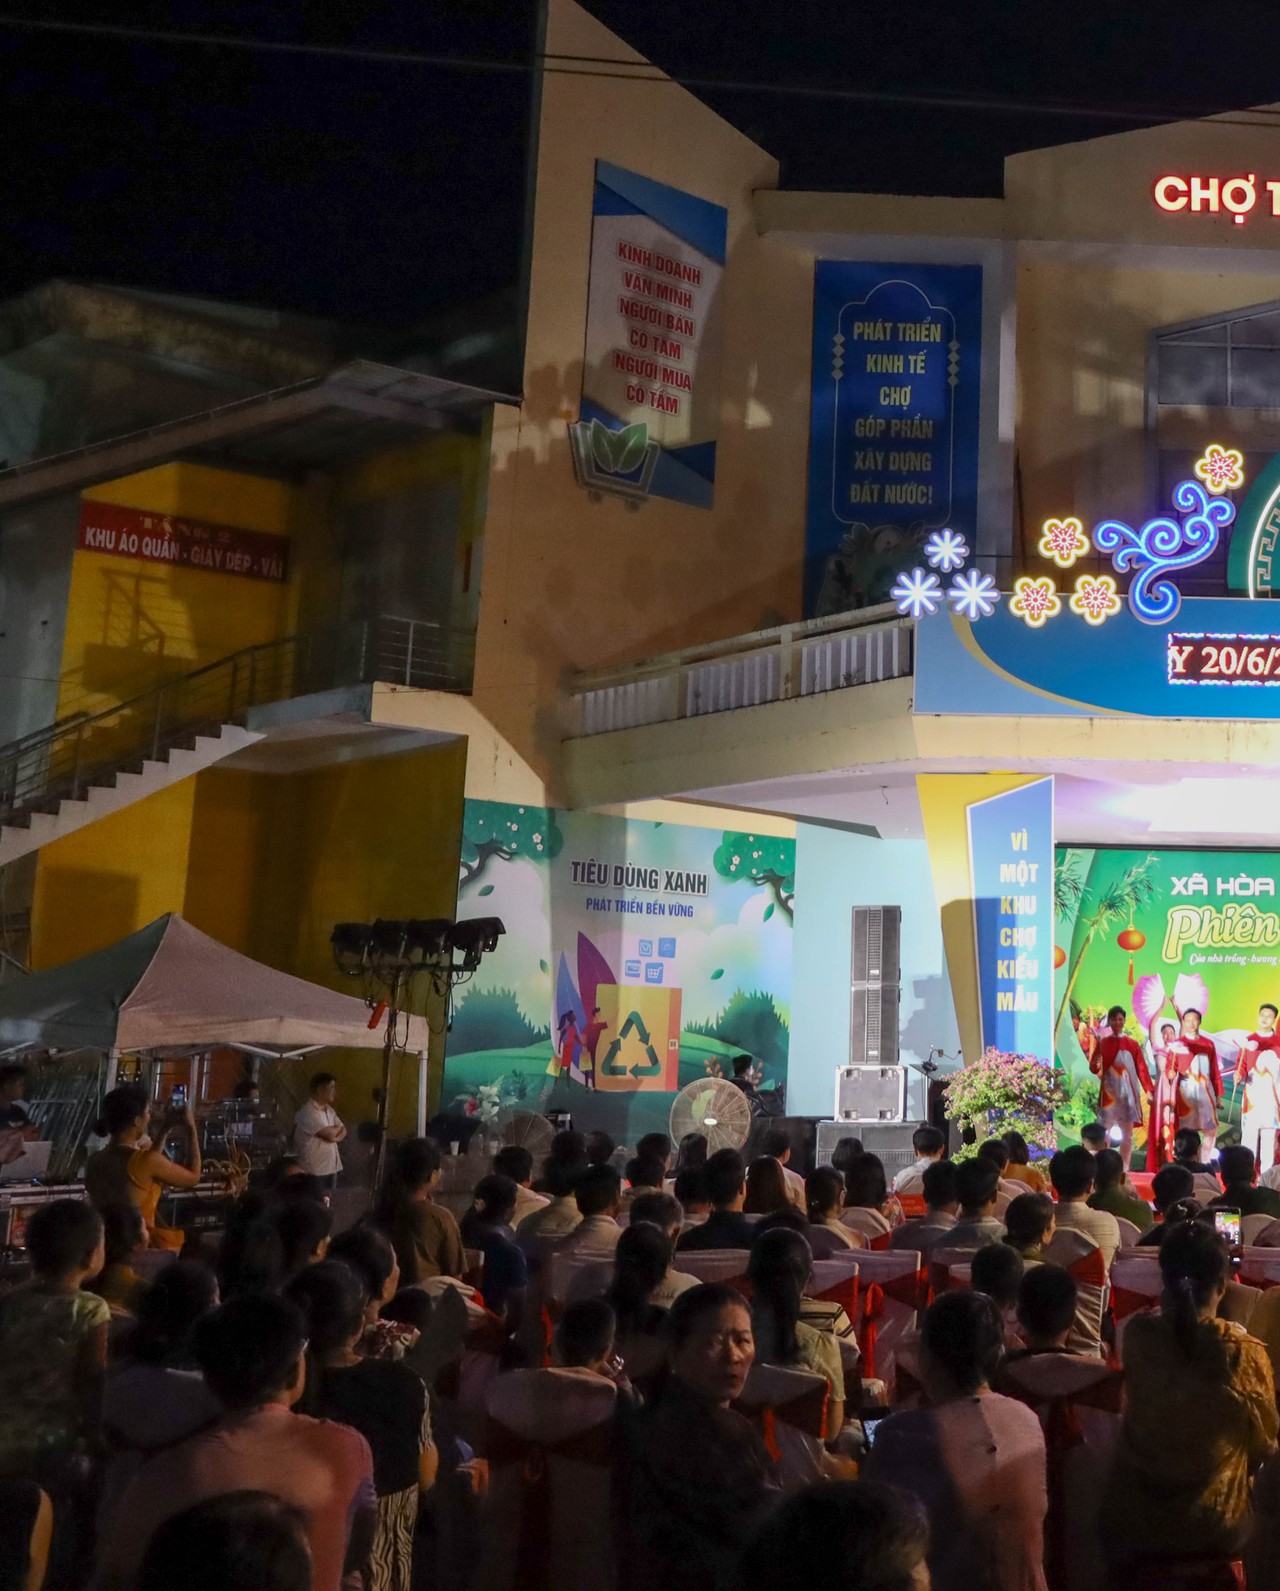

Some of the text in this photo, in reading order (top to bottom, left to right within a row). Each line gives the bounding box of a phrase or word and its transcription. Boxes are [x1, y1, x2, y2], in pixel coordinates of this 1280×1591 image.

[1154, 173, 1256, 224] CHỢ
[617, 242, 702, 285] KINH DOANH
[624, 268, 693, 309] VĂN MINH
[619, 297, 694, 337] NGƯỜI BÁN
[853, 316, 941, 342] PHÁT TRIỂN
[629, 326, 681, 360] CÓ TÂM
[615, 352, 692, 391] NGƯỜI MUA
[866, 349, 928, 374] KINH TẾ
[626, 382, 645, 405] CÓ
[879, 385, 912, 410] CHỢ
[854, 412, 934, 439] GÓP PHẦN
[853, 448, 932, 475] XÂY DỰNG
[849, 477, 933, 505] ĐẤT NƯỚC!
[85, 525, 116, 550] KHU
[118, 527, 138, 554] ÁO
[141, 533, 180, 560] QUẦN
[190, 542, 223, 568] GIÀY
[225, 548, 251, 573] DÉP
[1010, 828, 1028, 851] VÌ
[571, 857, 708, 894] TIÊU DÙNG XANH
[1000, 860, 1038, 887] MỘT
[1170, 872, 1208, 896] XÃ
[1216, 873, 1275, 897] HÒA
[586, 897, 612, 912] PHÁT
[615, 896, 643, 914] TRIỂN
[668, 901, 694, 918] VỮNG
[1000, 895, 1037, 916] KHU
[1000, 926, 1037, 951] CHỢ
[1163, 904, 1280, 961] Phiên
[1189, 952, 1206, 965] Của
[1207, 953, 1223, 963] nhà
[1224, 952, 1247, 966] trồng
[1251, 952, 1278, 967] hương
